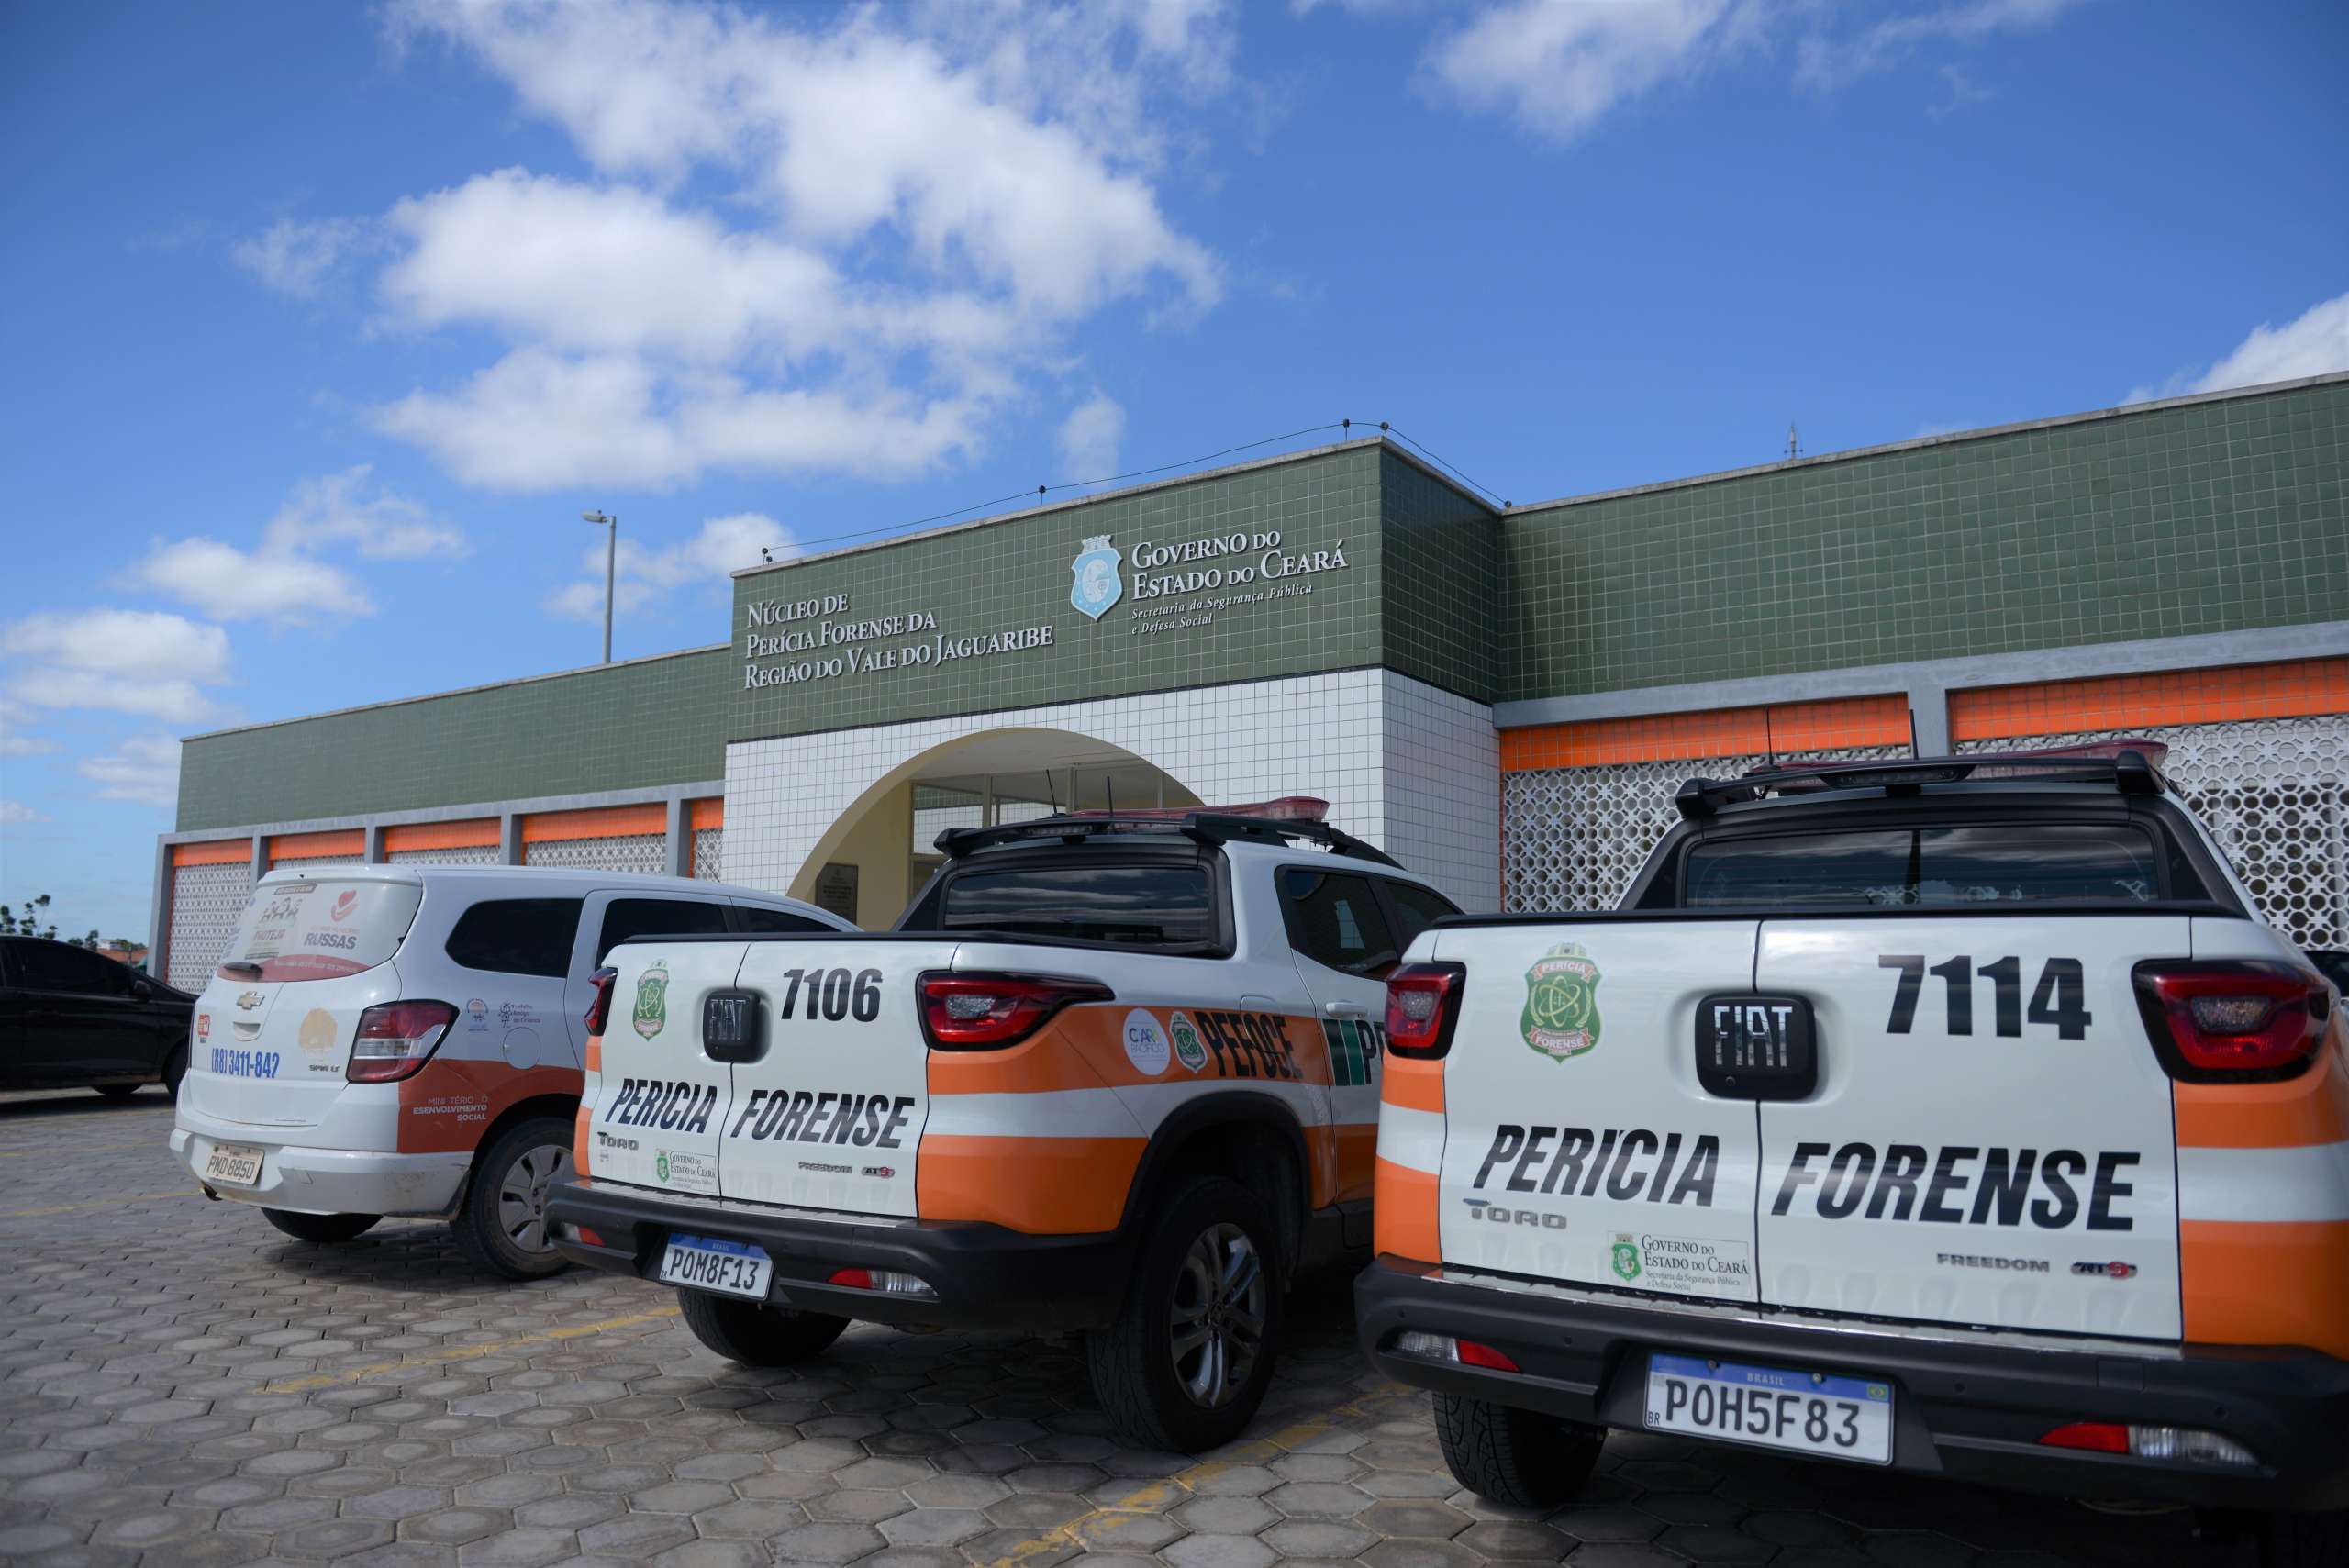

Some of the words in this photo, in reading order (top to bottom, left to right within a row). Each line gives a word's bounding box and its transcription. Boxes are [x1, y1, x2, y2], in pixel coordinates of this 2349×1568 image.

[1131, 533, 1247, 569] GOVERNO
[1253, 530, 1281, 549] DO
[1131, 569, 1222, 600] ESTADO
[1228, 567, 1254, 586] DO
[1260, 539, 1349, 579] CEARÁ
[746, 599, 820, 628] NÚCLEO
[825, 594, 850, 613] DE
[1131, 602, 1186, 620] Secretaria
[1189, 599, 1203, 611] da
[1207, 590, 1264, 611] Segurança
[1269, 583, 1312, 599] Pública
[745, 629, 816, 659] PERÍCIA
[819, 617, 905, 648] FORENSE
[908, 610, 937, 633] DA
[1131, 626, 1138, 635] e
[1141, 619, 1175, 635] Defesa
[1179, 613, 1213, 628] Social
[744, 660, 812, 689] REGIÃO
[816, 658, 842, 679] DO
[846, 648, 897, 673] VALE
[902, 645, 931, 667] DO
[934, 625, 1054, 667] JAGUARIBE
[304, 932, 357, 949] RUSSAS
[781, 967, 884, 1023] 7106
[1878, 954, 2092, 1040] 7114
[711, 999, 746, 1040] FIAT
[1714, 1006, 1793, 1068] FIAT
[1194, 1011, 1304, 1079] PEFOCE
[1535, 1036, 1585, 1050] FORENSE
[457, 1113, 486, 1121] SOCIAL
[605, 1077, 718, 1134] PERÍCIA
[730, 1088, 916, 1149] FORENSE
[597, 1131, 639, 1151] TORO
[1473, 1124, 1720, 1207] PERÍCIA
[1771, 1141, 2142, 1231] FORENSE
[1463, 1197, 1568, 1230] TORO
[1641, 1234, 1698, 1254] GOVERNO
[1701, 1246, 1715, 1256] DO
[1644, 1251, 1689, 1271] ESTADO
[1691, 1261, 1705, 1272] DO
[1708, 1256, 1750, 1275] CEARÁ
[1936, 1252, 2051, 1273] FREEDOM
[669, 1248, 760, 1290] POM8F13
[1746, 1372, 1785, 1386] BRASIL
[1648, 1411, 1660, 1426] BR
[1665, 1378, 1860, 1448] POH5F83
